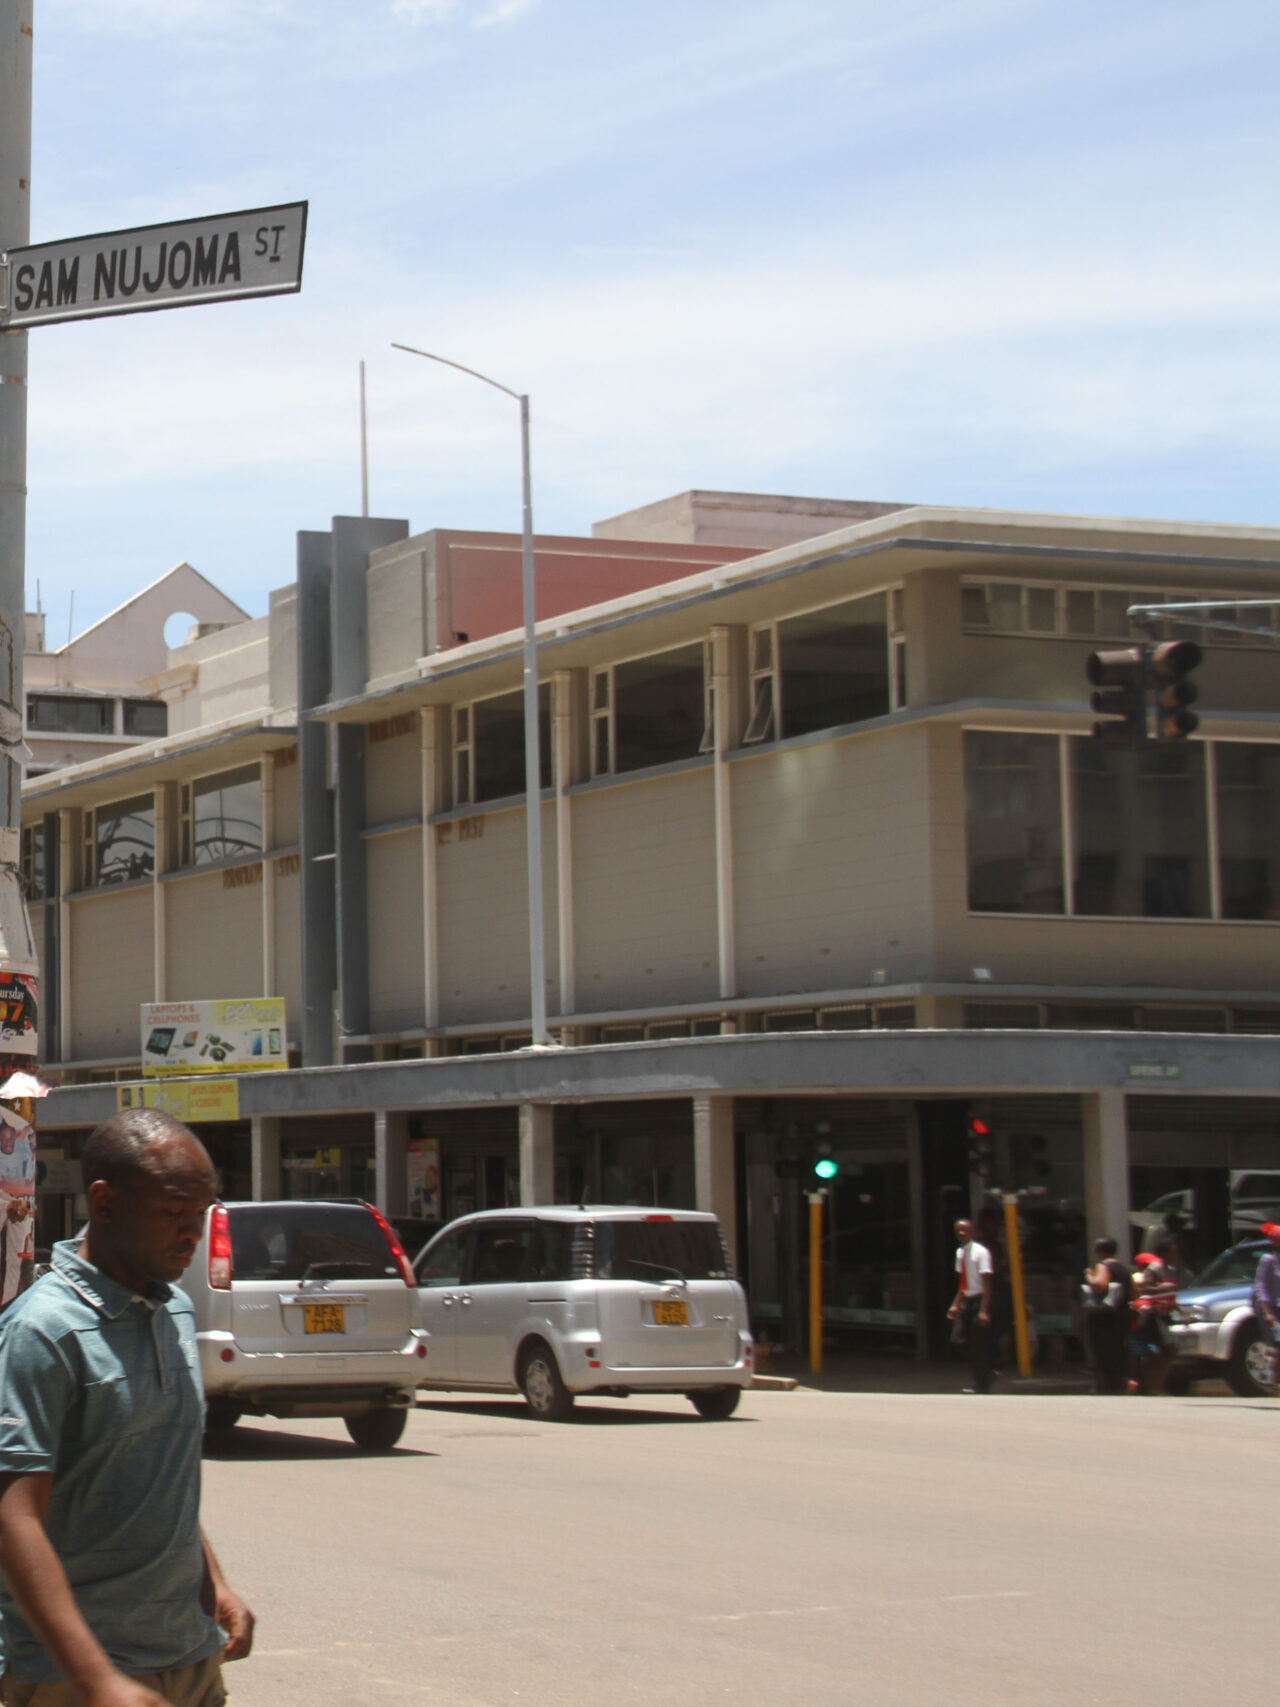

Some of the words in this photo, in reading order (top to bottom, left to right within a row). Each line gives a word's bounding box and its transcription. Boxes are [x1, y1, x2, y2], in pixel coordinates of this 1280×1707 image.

[14, 256, 80, 312] SAM
[93, 231, 241, 300] NUJOMA
[254, 225, 285, 262] ST
[150, 1003, 188, 1015] LAPTOPS
[146, 1014, 201, 1025] CELLPHONES
